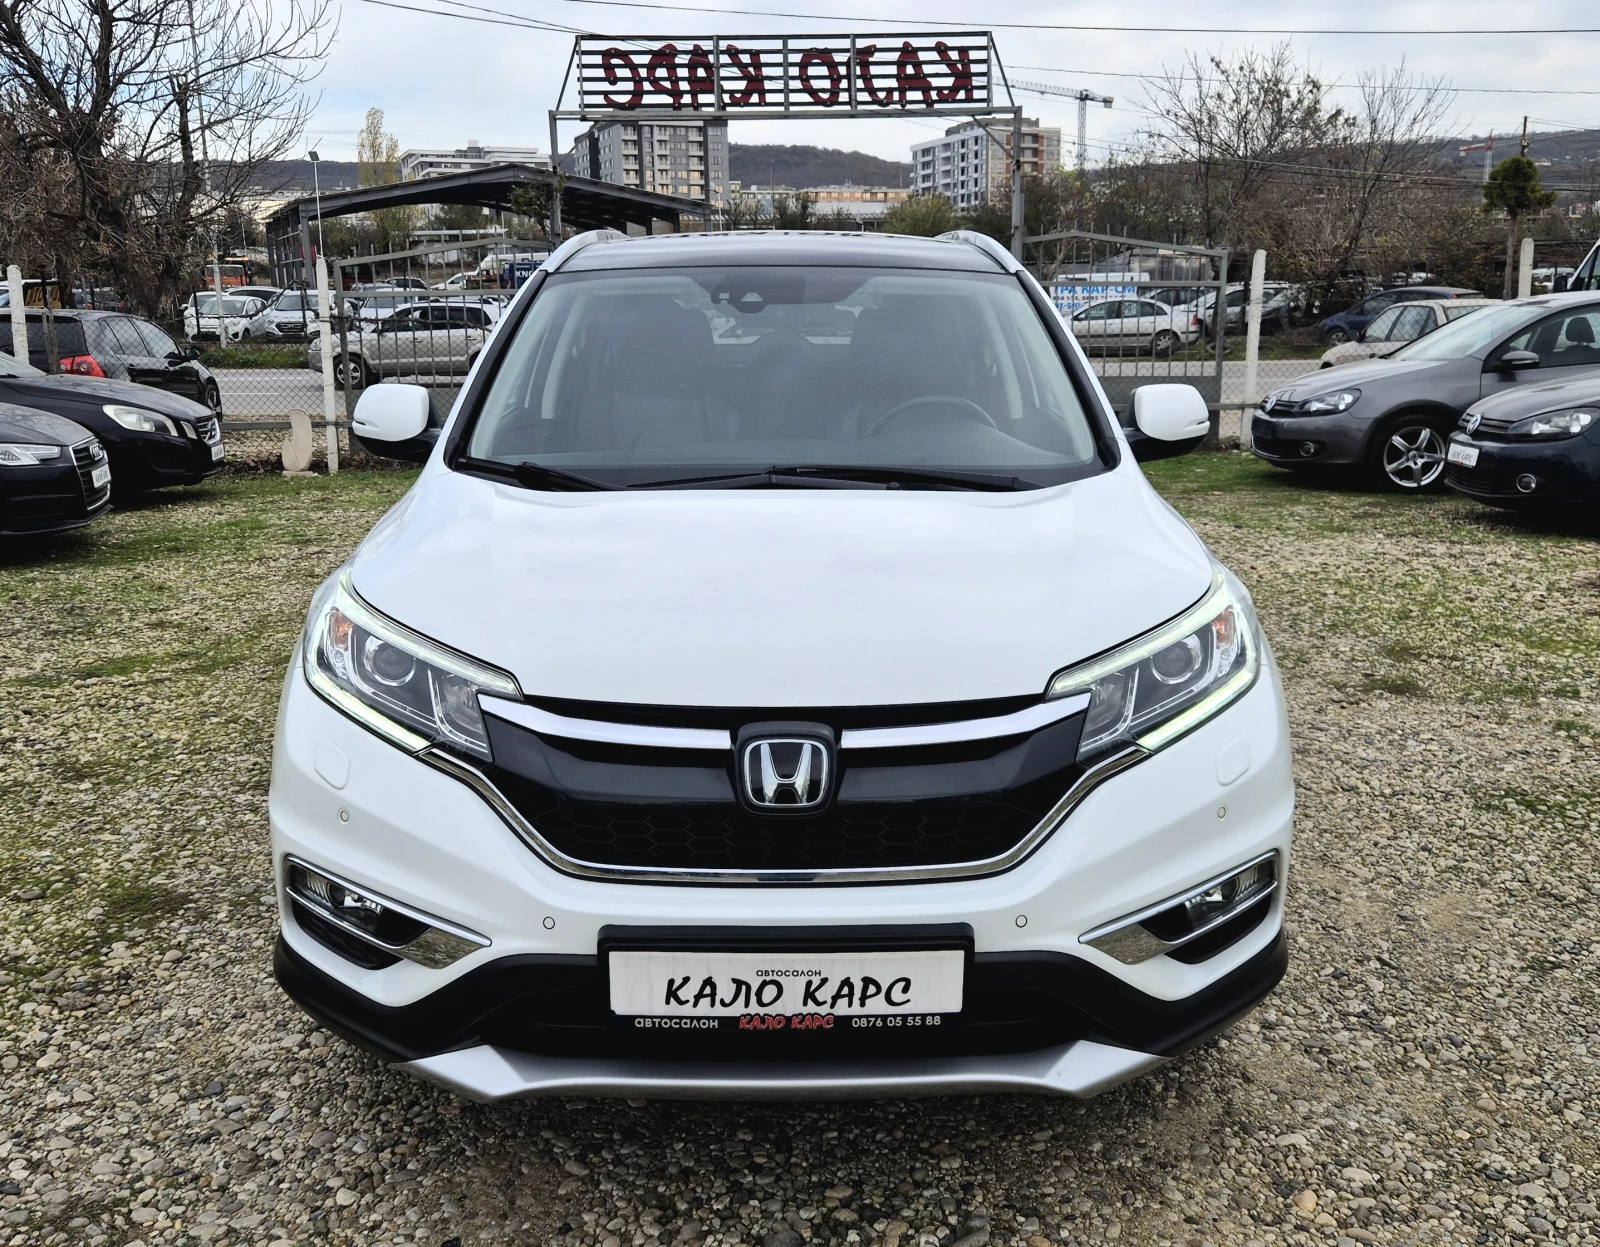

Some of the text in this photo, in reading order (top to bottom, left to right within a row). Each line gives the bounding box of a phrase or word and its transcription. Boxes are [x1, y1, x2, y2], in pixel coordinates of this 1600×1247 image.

[755, 968, 822, 978] автосалон
[664, 975, 912, 1008] КАЛО КАРС
[738, 1014, 787, 1031] КАЛО
[791, 1013, 835, 1030] КАРС
[851, 1017, 883, 1028] 0876
[887, 1016, 903, 1027] 05
[906, 1016, 922, 1027] 55
[925, 1015, 942, 1026] 88
